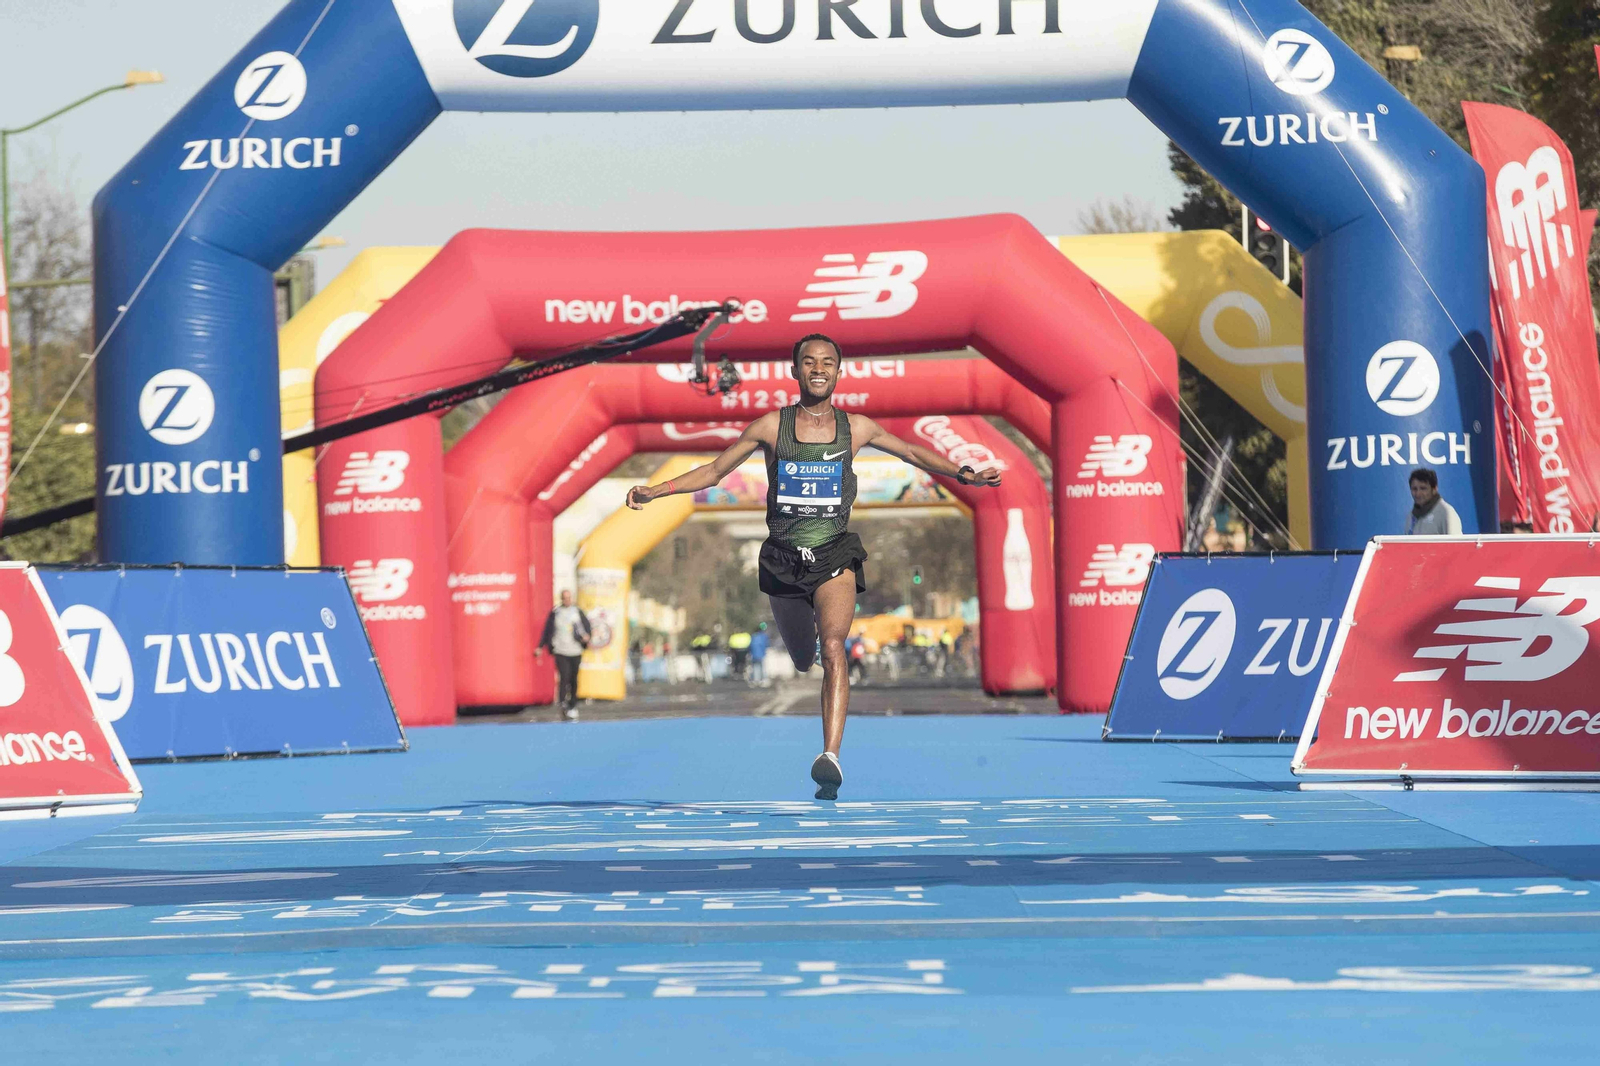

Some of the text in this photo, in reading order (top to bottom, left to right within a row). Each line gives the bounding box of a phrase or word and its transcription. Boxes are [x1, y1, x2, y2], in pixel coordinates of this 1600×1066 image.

[651, 0, 1062, 44] ZURICH
[1218, 113, 1378, 147] ZURICH
[179, 137, 342, 170] ZURICH
[545, 299, 617, 324] new
[1327, 432, 1472, 471] ZURICH
[105, 461, 249, 496] ZURICH
[799, 465, 835, 474] ZURICH
[801, 482, 817, 495] 21
[1066, 479, 1163, 498] new balance
[323, 496, 421, 516] new balance
[1069, 592, 1097, 606] new
[144, 632, 341, 694] ZURICH
[1344, 705, 1432, 739] new
